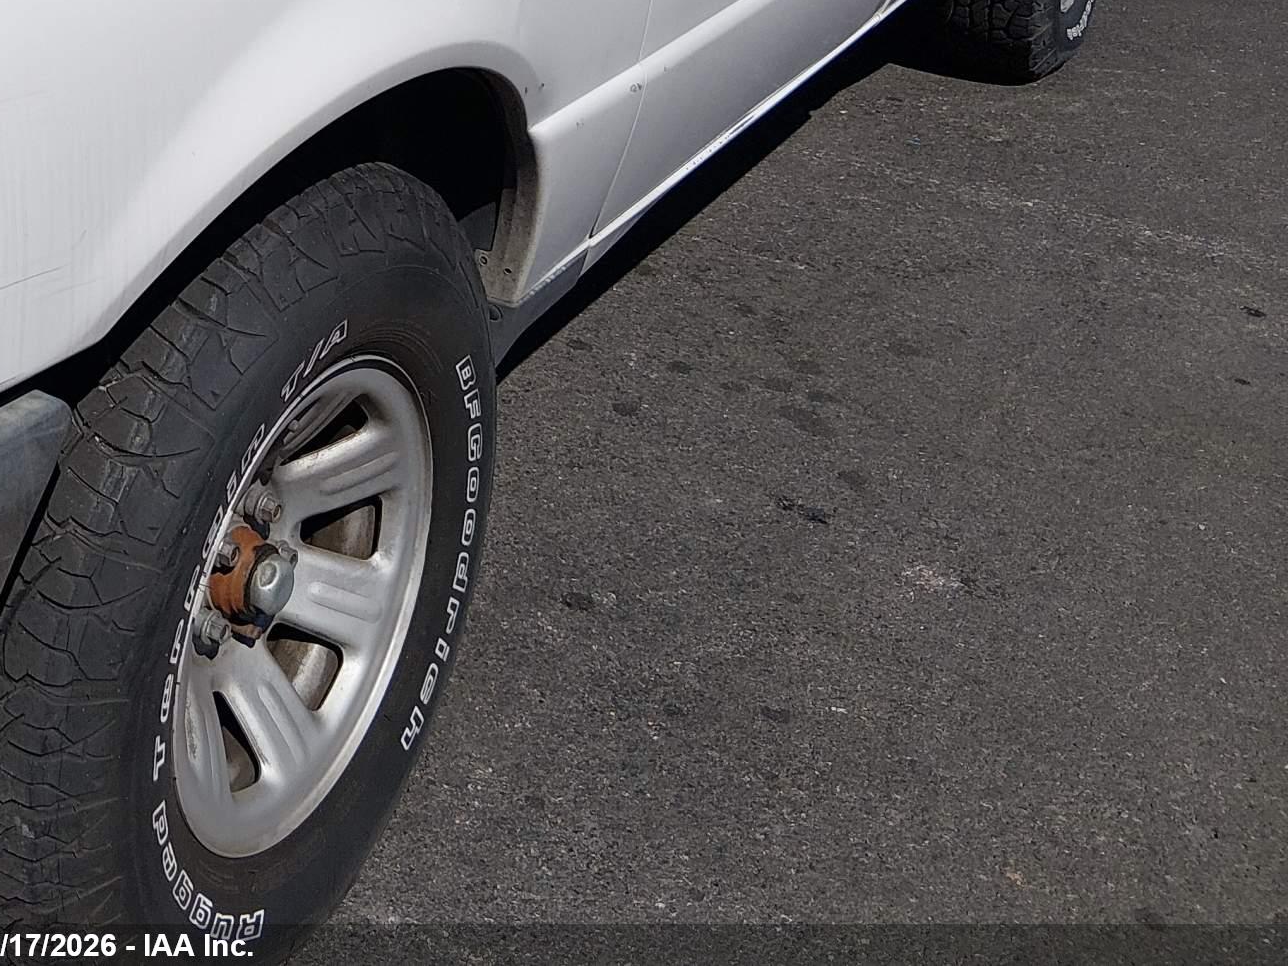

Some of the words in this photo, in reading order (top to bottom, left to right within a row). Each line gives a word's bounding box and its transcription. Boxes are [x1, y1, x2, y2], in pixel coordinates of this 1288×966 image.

[281, 319, 347, 402] T/A
[401, 354, 482, 751] BFGoodrich
[152, 800, 265, 941] Rugged
